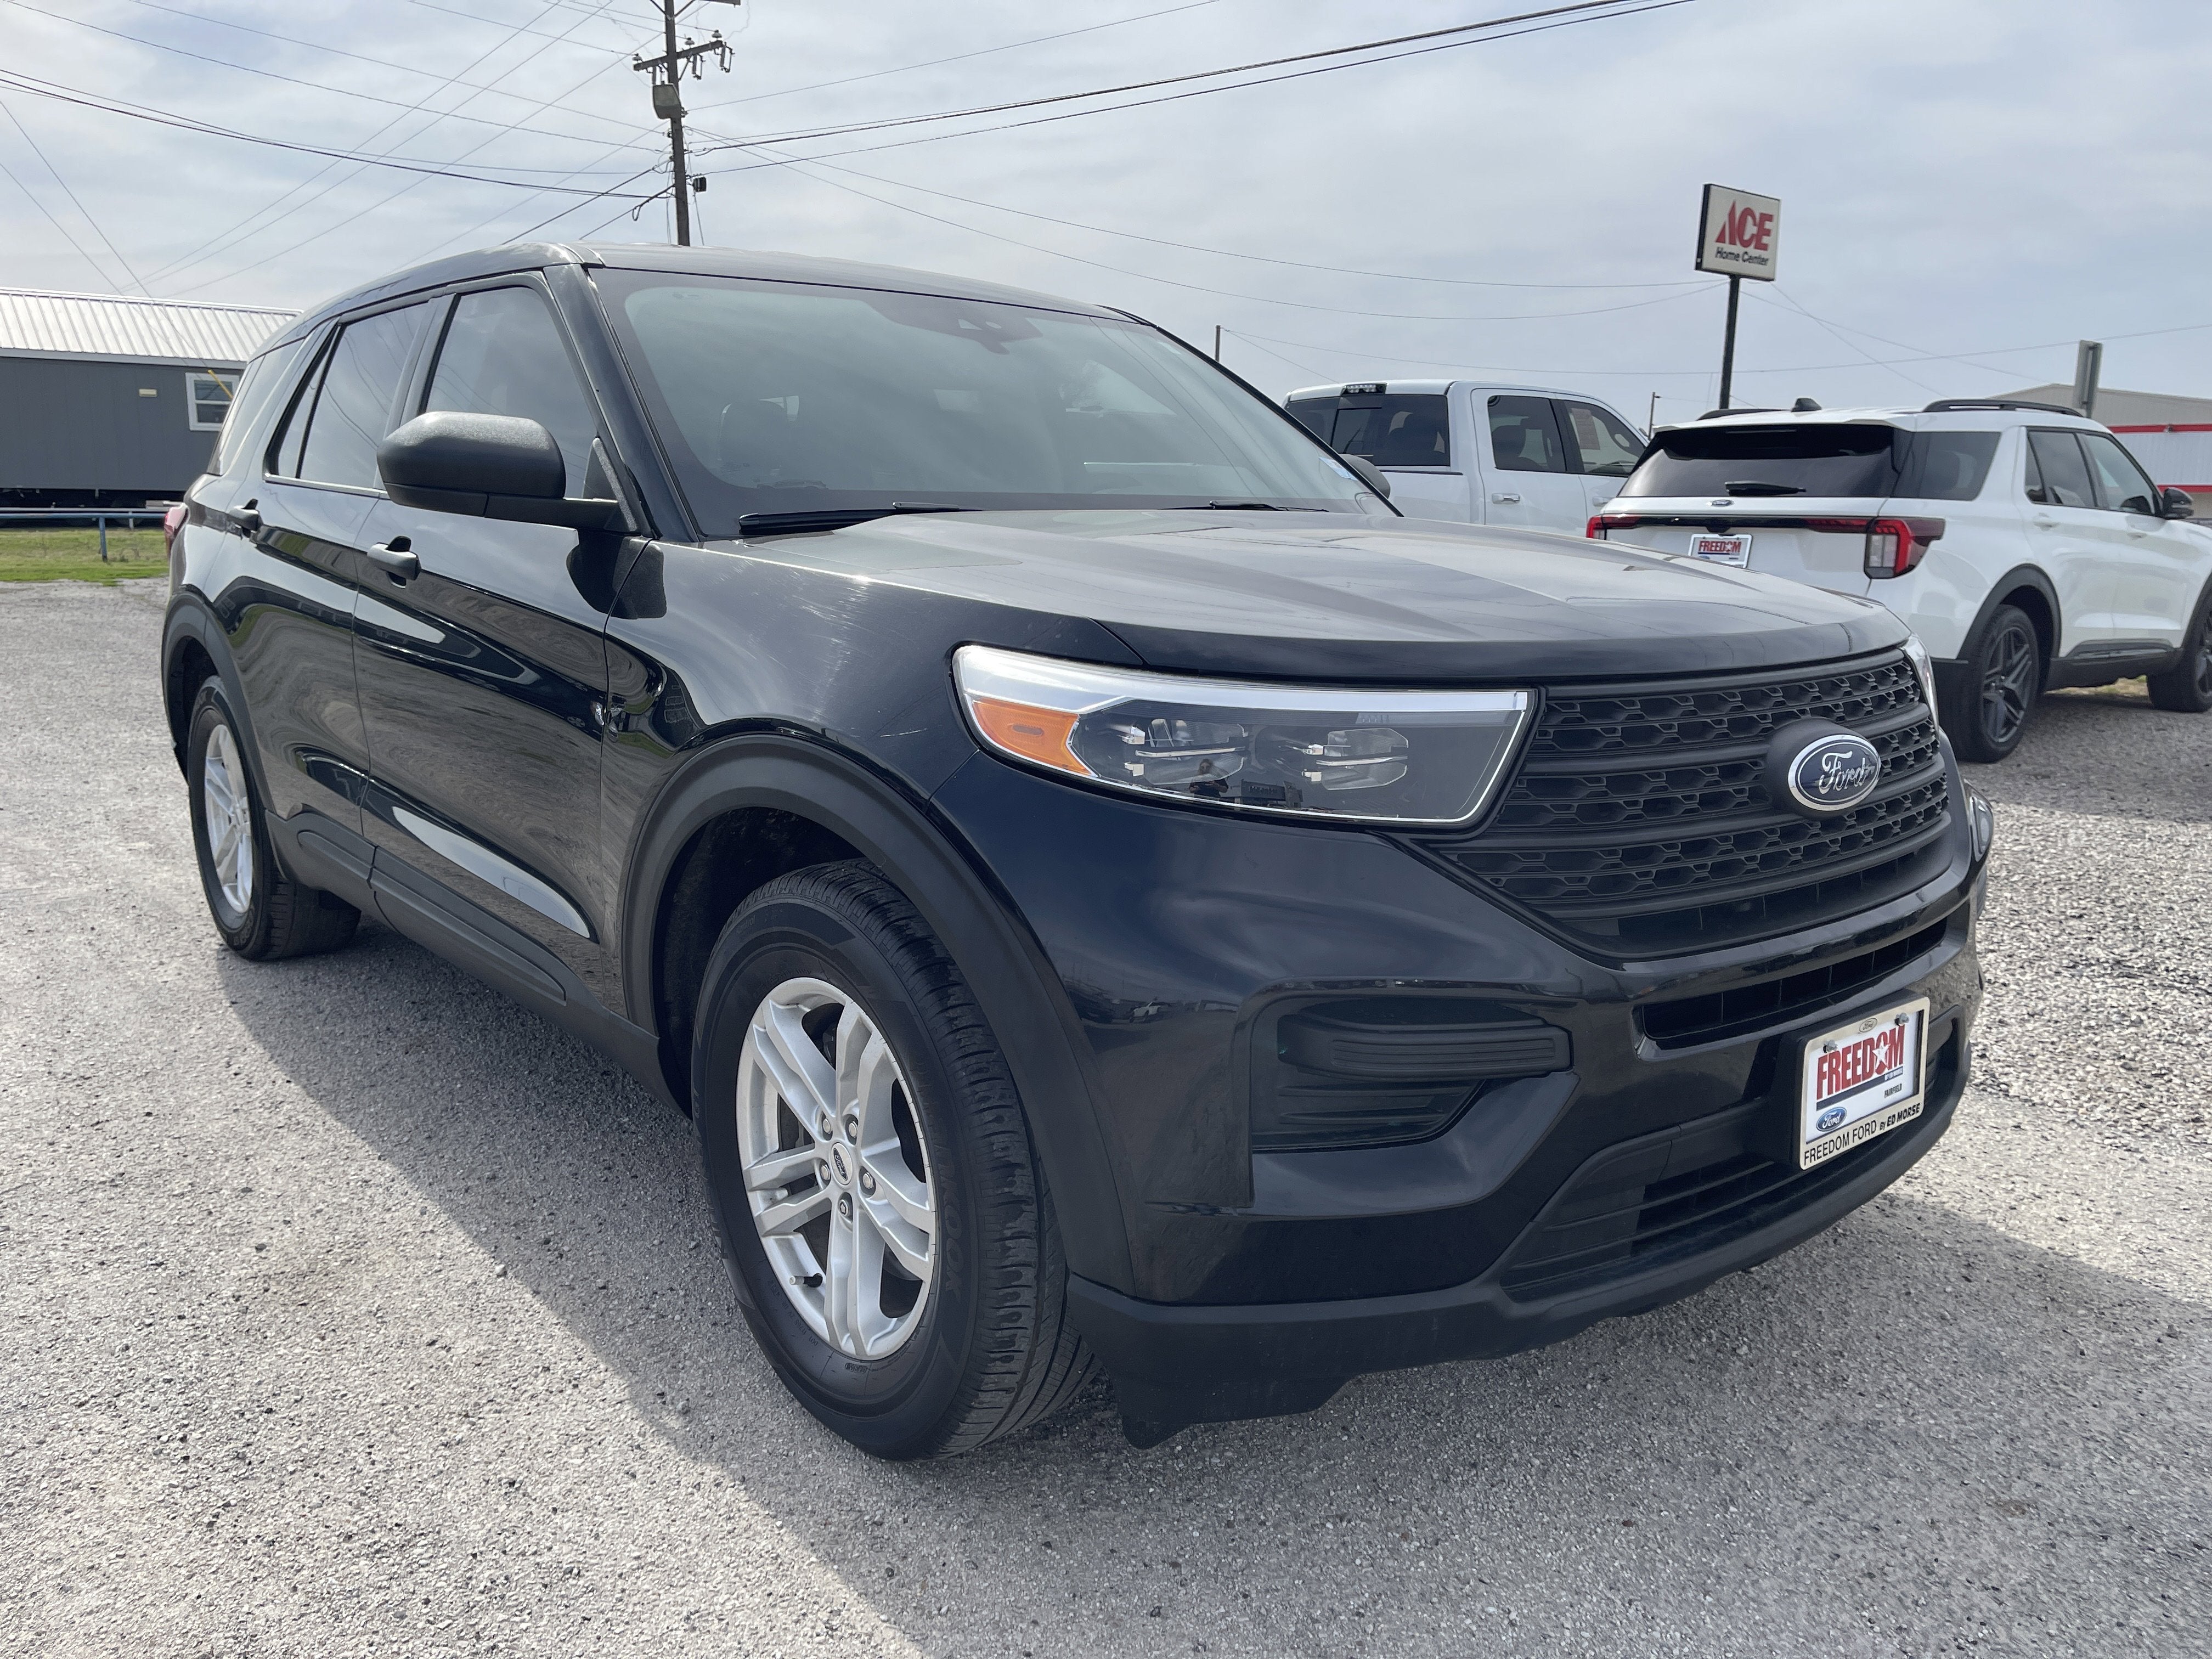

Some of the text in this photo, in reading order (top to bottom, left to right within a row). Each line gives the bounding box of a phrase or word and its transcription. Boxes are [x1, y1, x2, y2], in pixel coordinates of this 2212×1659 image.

[1715, 199, 1774, 251] ACE
[1714, 247, 1770, 266] Home Center
[1699, 540, 1742, 552] FREEDOM
[1819, 751, 1866, 795] Ford
[1816, 1024, 1905, 1101] FREEDOM
[1804, 1132, 1849, 1166] FREEDOM
[1852, 1120, 1877, 1143] FORD
[1887, 1114, 1895, 1127] ED
[1897, 1102, 1921, 1123] MORSE
[1822, 1111, 1841, 1129] Ford
